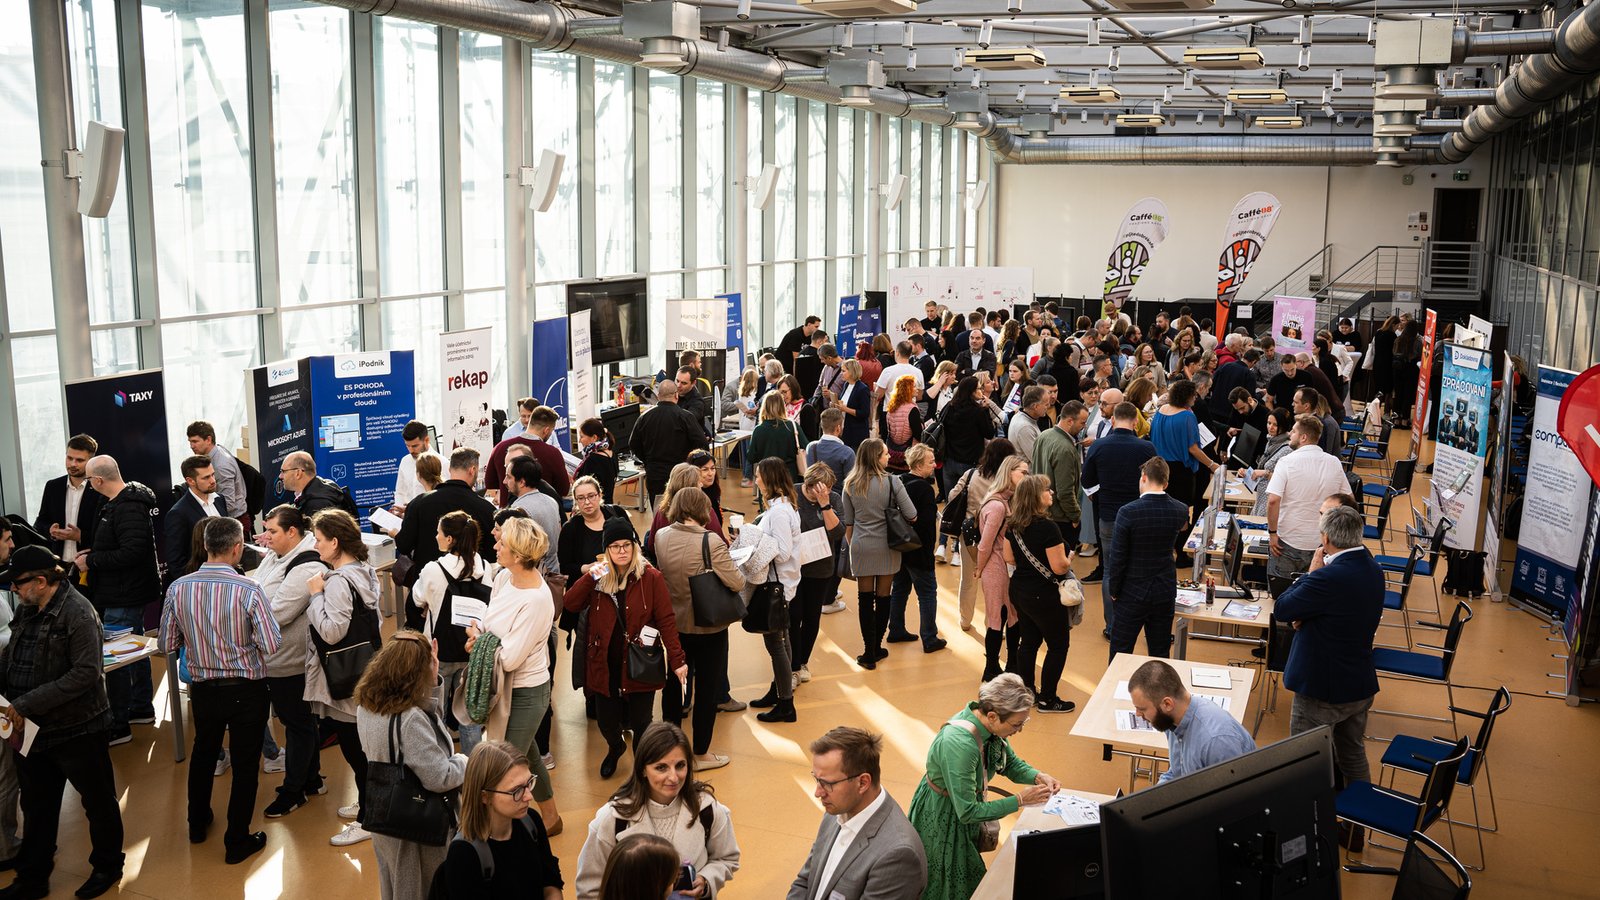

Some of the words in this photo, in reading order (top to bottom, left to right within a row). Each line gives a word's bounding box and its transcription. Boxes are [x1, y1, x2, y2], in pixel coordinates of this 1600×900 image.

[698, 341, 717, 349] MONEY
[448, 370, 488, 390] rekap
[1443, 377, 1486, 398] ZPRACOVÁNÍ
[129, 391, 153, 402] TAXY
[343, 390, 391, 400] profesionálním
[268, 433, 292, 447] MICROSOFT
[293, 429, 306, 439] AZURE
